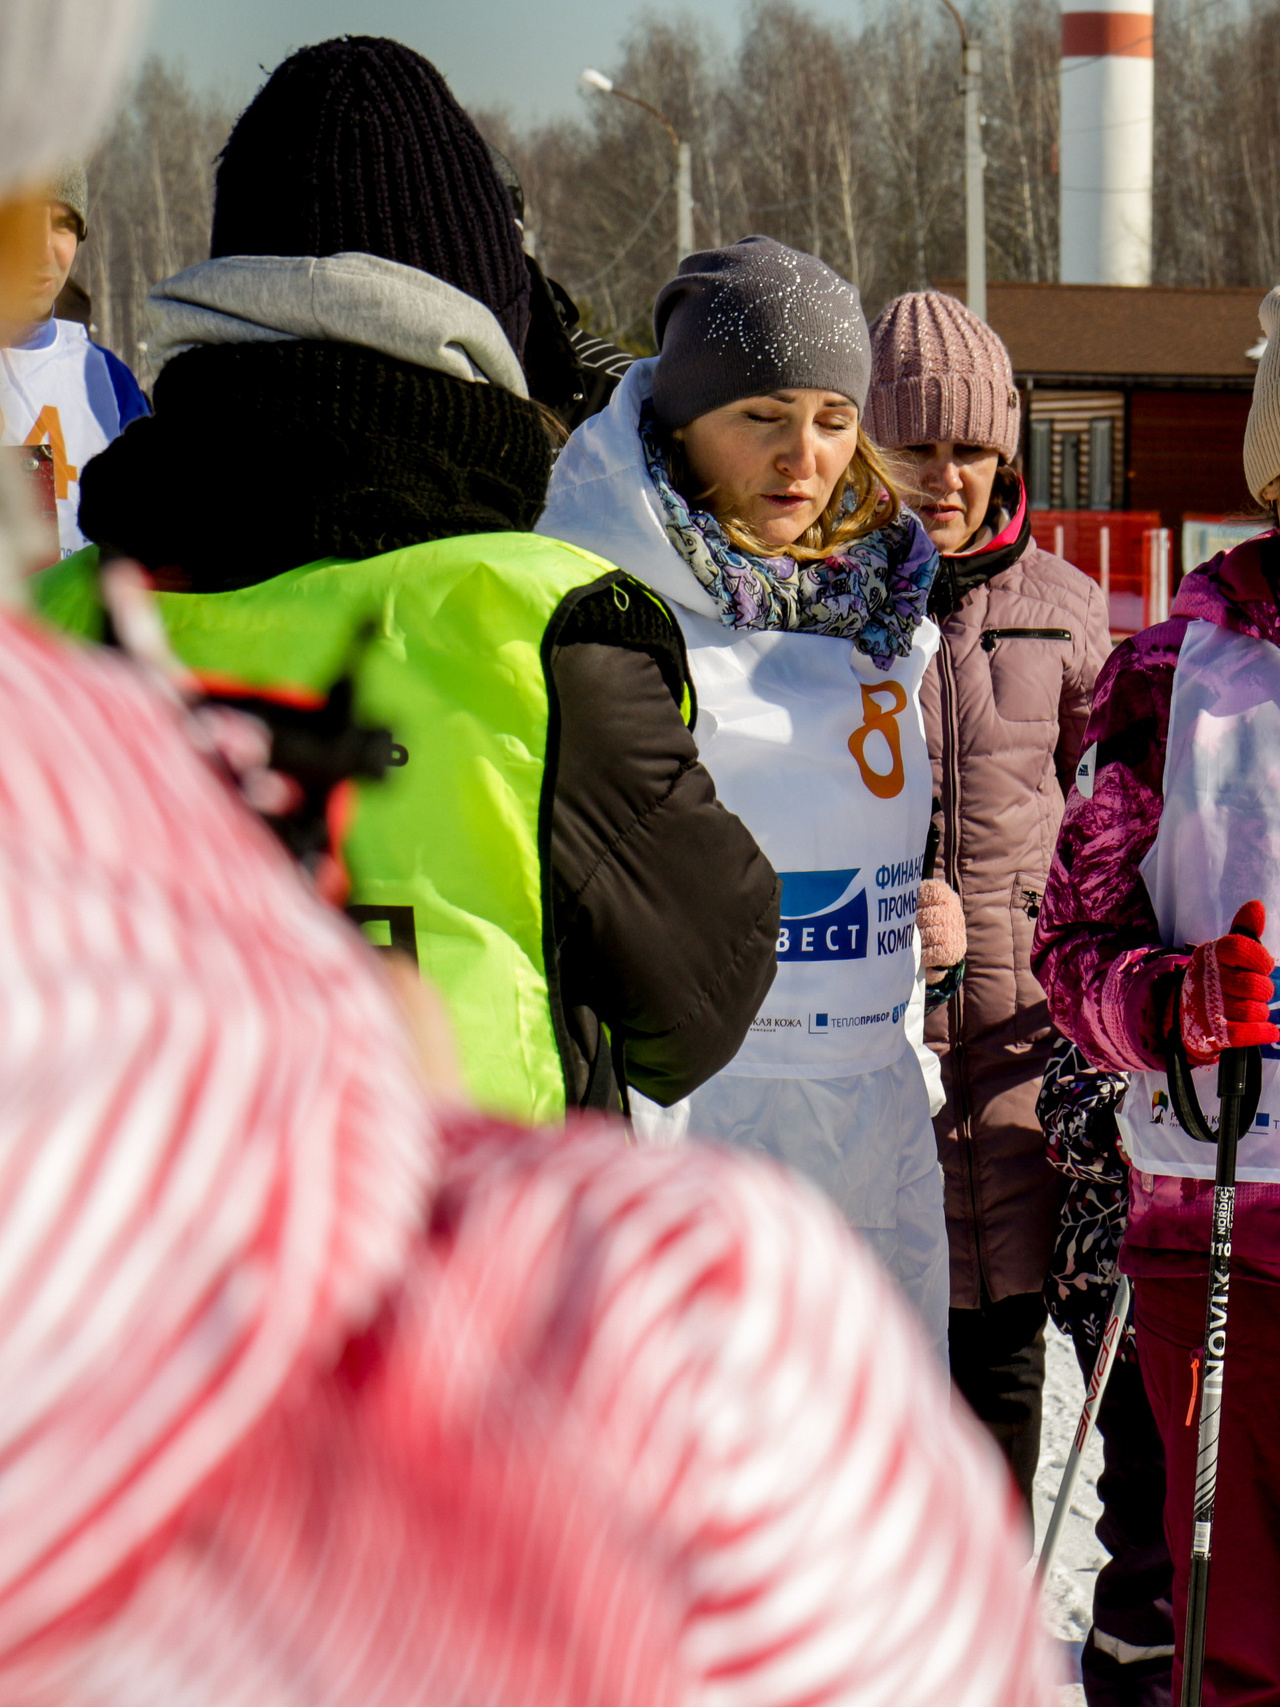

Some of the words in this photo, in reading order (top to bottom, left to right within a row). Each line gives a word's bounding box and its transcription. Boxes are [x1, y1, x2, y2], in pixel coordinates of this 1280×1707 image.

[848, 680, 907, 799] 8
[875, 853, 924, 890] ФИНАНС
[878, 886, 920, 923] ПРОМЫ
[775, 924, 860, 953] ВЕСТ
[877, 922, 914, 956] КОМП
[775, 1018, 802, 1028] КОЖА
[831, 1012, 890, 1028] ТЕПЛОПРИБОР
[1217, 1189, 1230, 1235] NORDIC
[1075, 1305, 1120, 1453] SPINE
